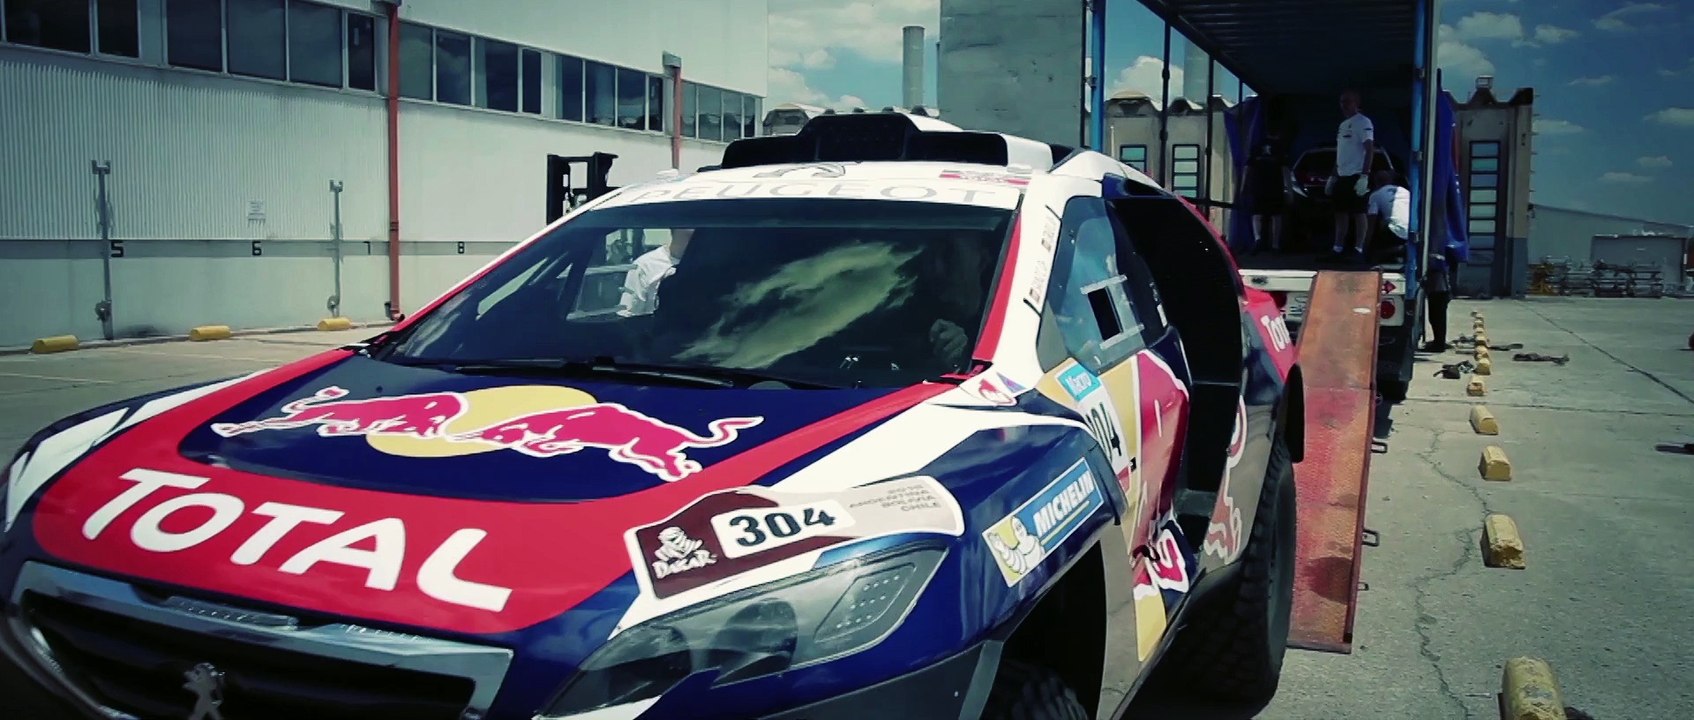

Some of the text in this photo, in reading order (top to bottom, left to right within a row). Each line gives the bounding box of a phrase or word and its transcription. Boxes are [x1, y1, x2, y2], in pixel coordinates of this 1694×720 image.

[629, 178, 996, 204] PEUGEOT
[110, 239, 124, 258] 5
[251, 239, 263, 257] 6
[457, 240, 466, 255] 8
[1032, 469, 1095, 539] MICHELIN
[82, 467, 513, 613] TOTAL
[729, 507, 836, 547] 304
